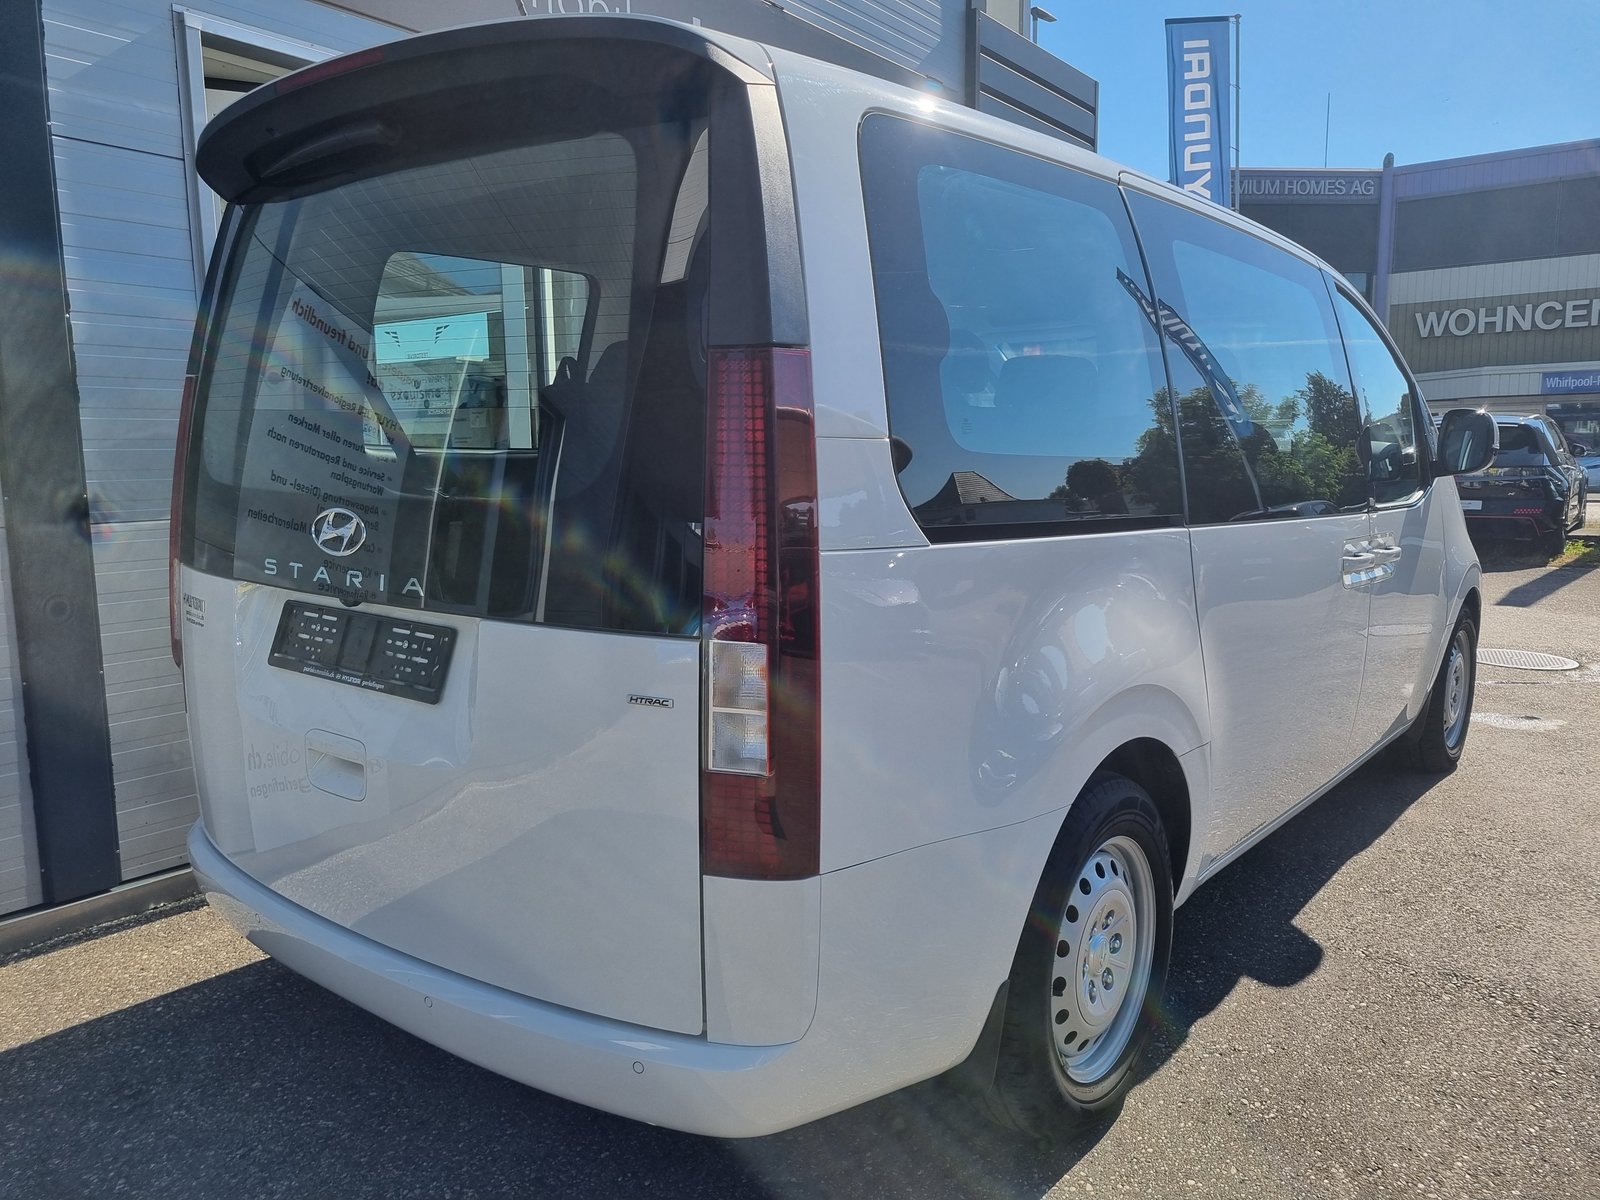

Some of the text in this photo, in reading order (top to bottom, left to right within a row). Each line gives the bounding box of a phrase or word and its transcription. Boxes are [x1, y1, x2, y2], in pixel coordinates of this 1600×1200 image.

[1284, 179, 1346, 195] HOMES
[1350, 179, 1375, 195] AG
[263, 558, 424, 597] STARIA
[629, 696, 670, 707] HTRAC
